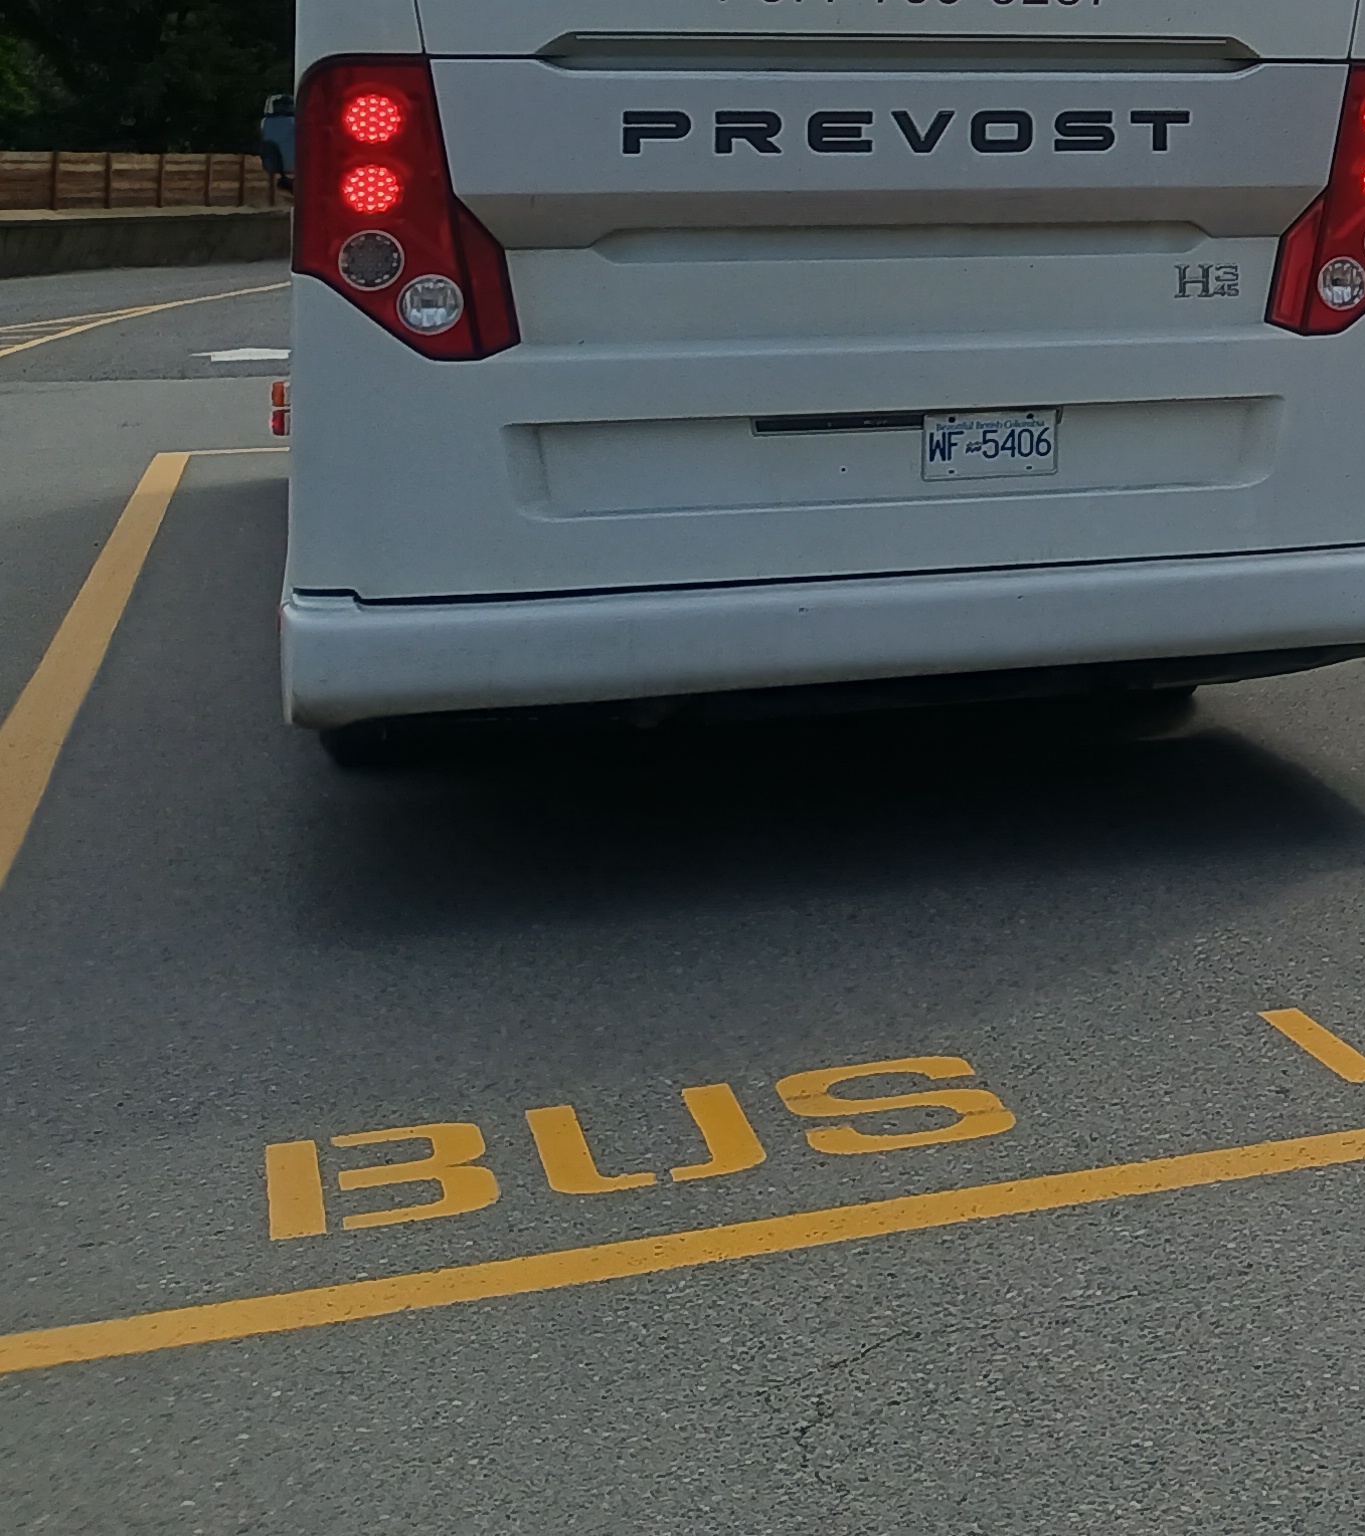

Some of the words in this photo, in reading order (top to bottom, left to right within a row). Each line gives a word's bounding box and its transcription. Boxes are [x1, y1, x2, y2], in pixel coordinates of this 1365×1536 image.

[622, 110, 1191, 155] PREVOST
[929, 430, 964, 462] WF
[982, 427, 1052, 459] 5406
[265, 1056, 1017, 1241] BUS
